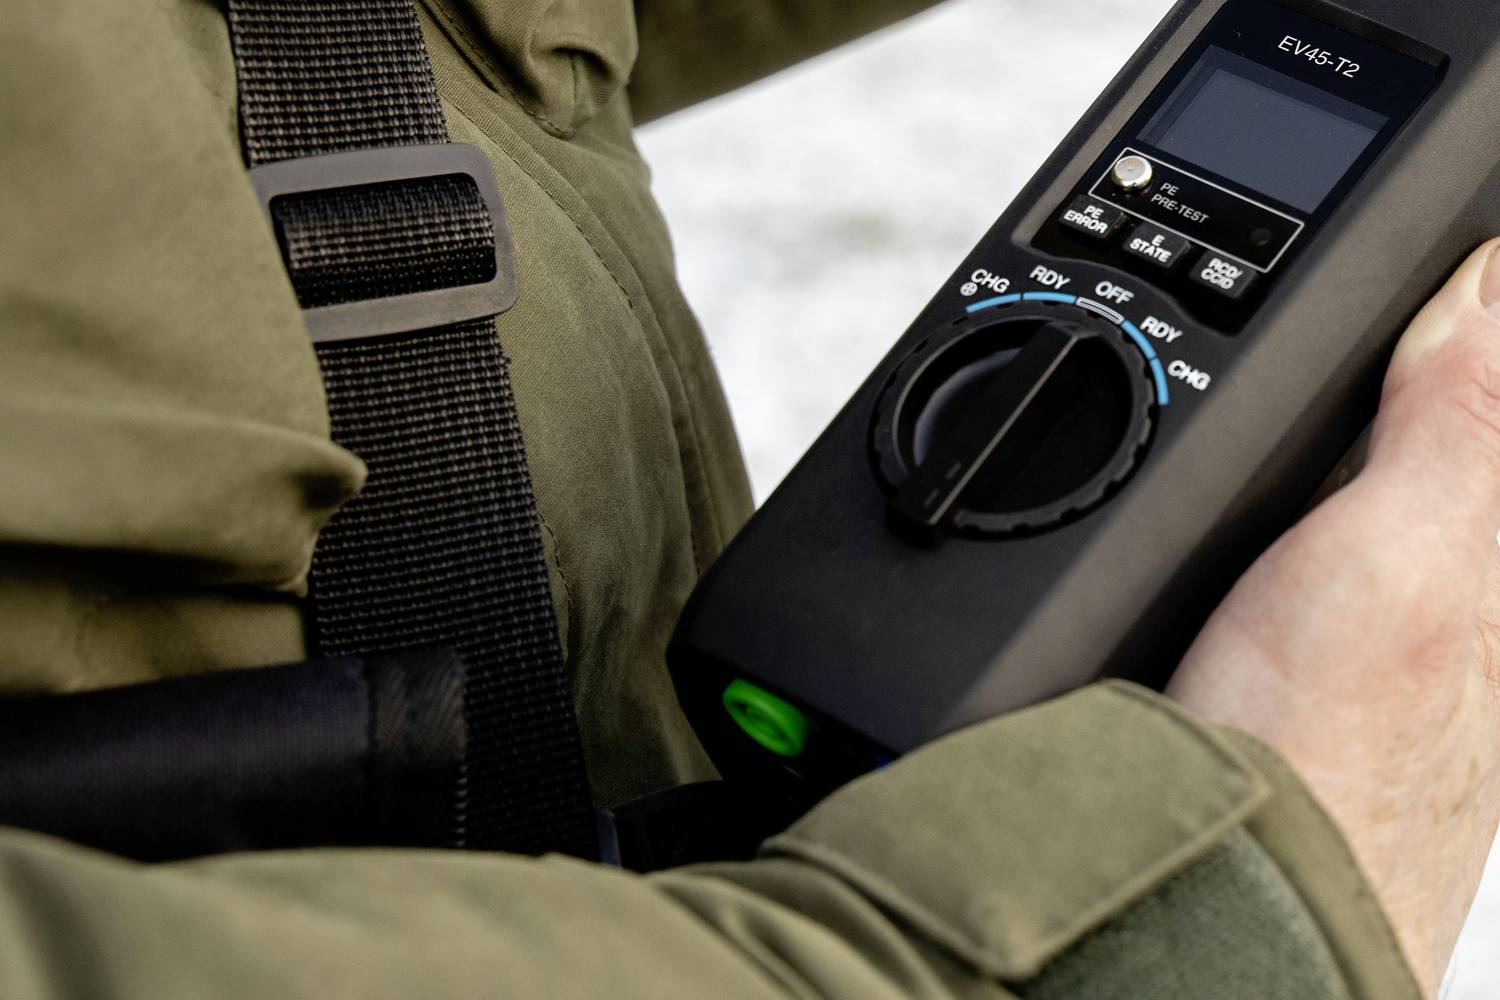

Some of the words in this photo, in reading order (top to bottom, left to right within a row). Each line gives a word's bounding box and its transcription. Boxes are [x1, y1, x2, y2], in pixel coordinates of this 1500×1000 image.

[1278, 35, 1360, 78] EV45-T2
[1159, 181, 1180, 197] PE
[1063, 209, 1109, 234] ERROR
[1083, 205, 1104, 220] PE
[1151, 194, 1210, 224] PRE-TEST
[1129, 237, 1172, 263] STATE
[1151, 234, 1165, 247] E
[970, 268, 1011, 294] CHG
[1029, 264, 1071, 291] RDY
[1094, 280, 1135, 305] OFF
[1139, 315, 1183, 343] RDY
[1167, 359, 1211, 391] CHG
